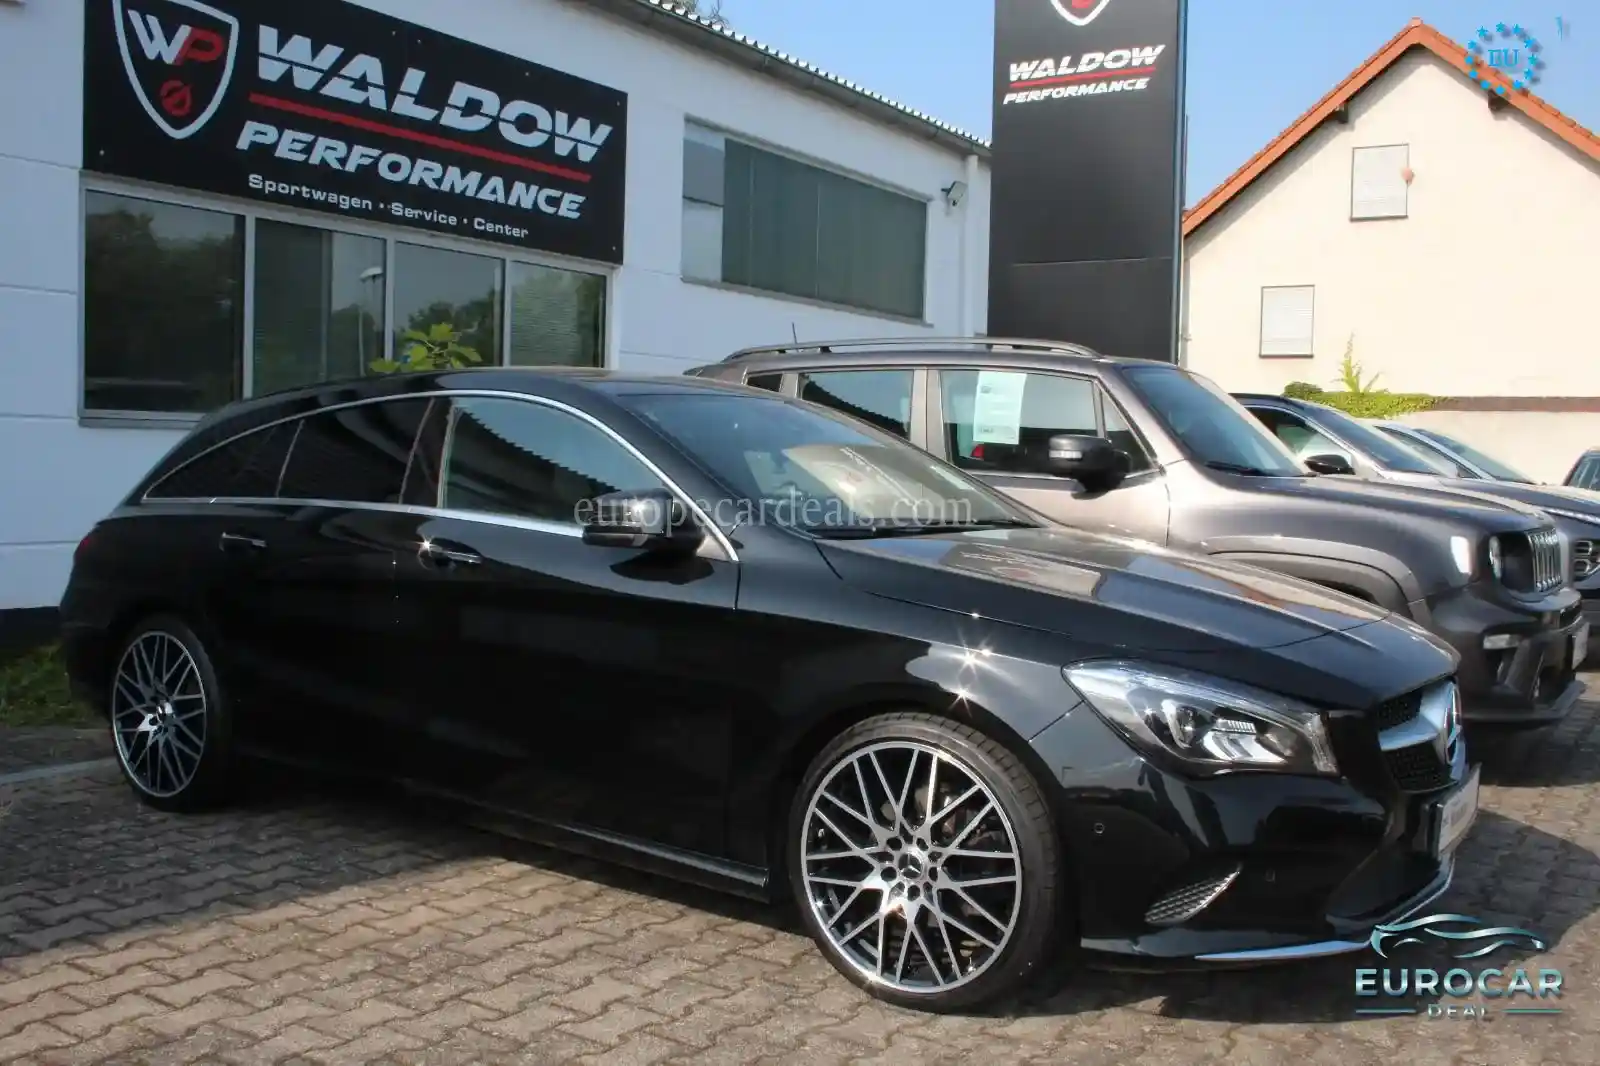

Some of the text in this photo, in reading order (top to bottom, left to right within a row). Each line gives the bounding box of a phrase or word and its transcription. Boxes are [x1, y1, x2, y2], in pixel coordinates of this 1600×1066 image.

[127, 9, 224, 66] WP
[1010, 44, 1166, 82] WALDOW
[258, 24, 613, 162] WALDOW
[1003, 77, 1150, 105] PERFORMANCE
[236, 120, 586, 220] PERFORMANCE
[248, 173, 529, 239] Sportwagen Service Center
